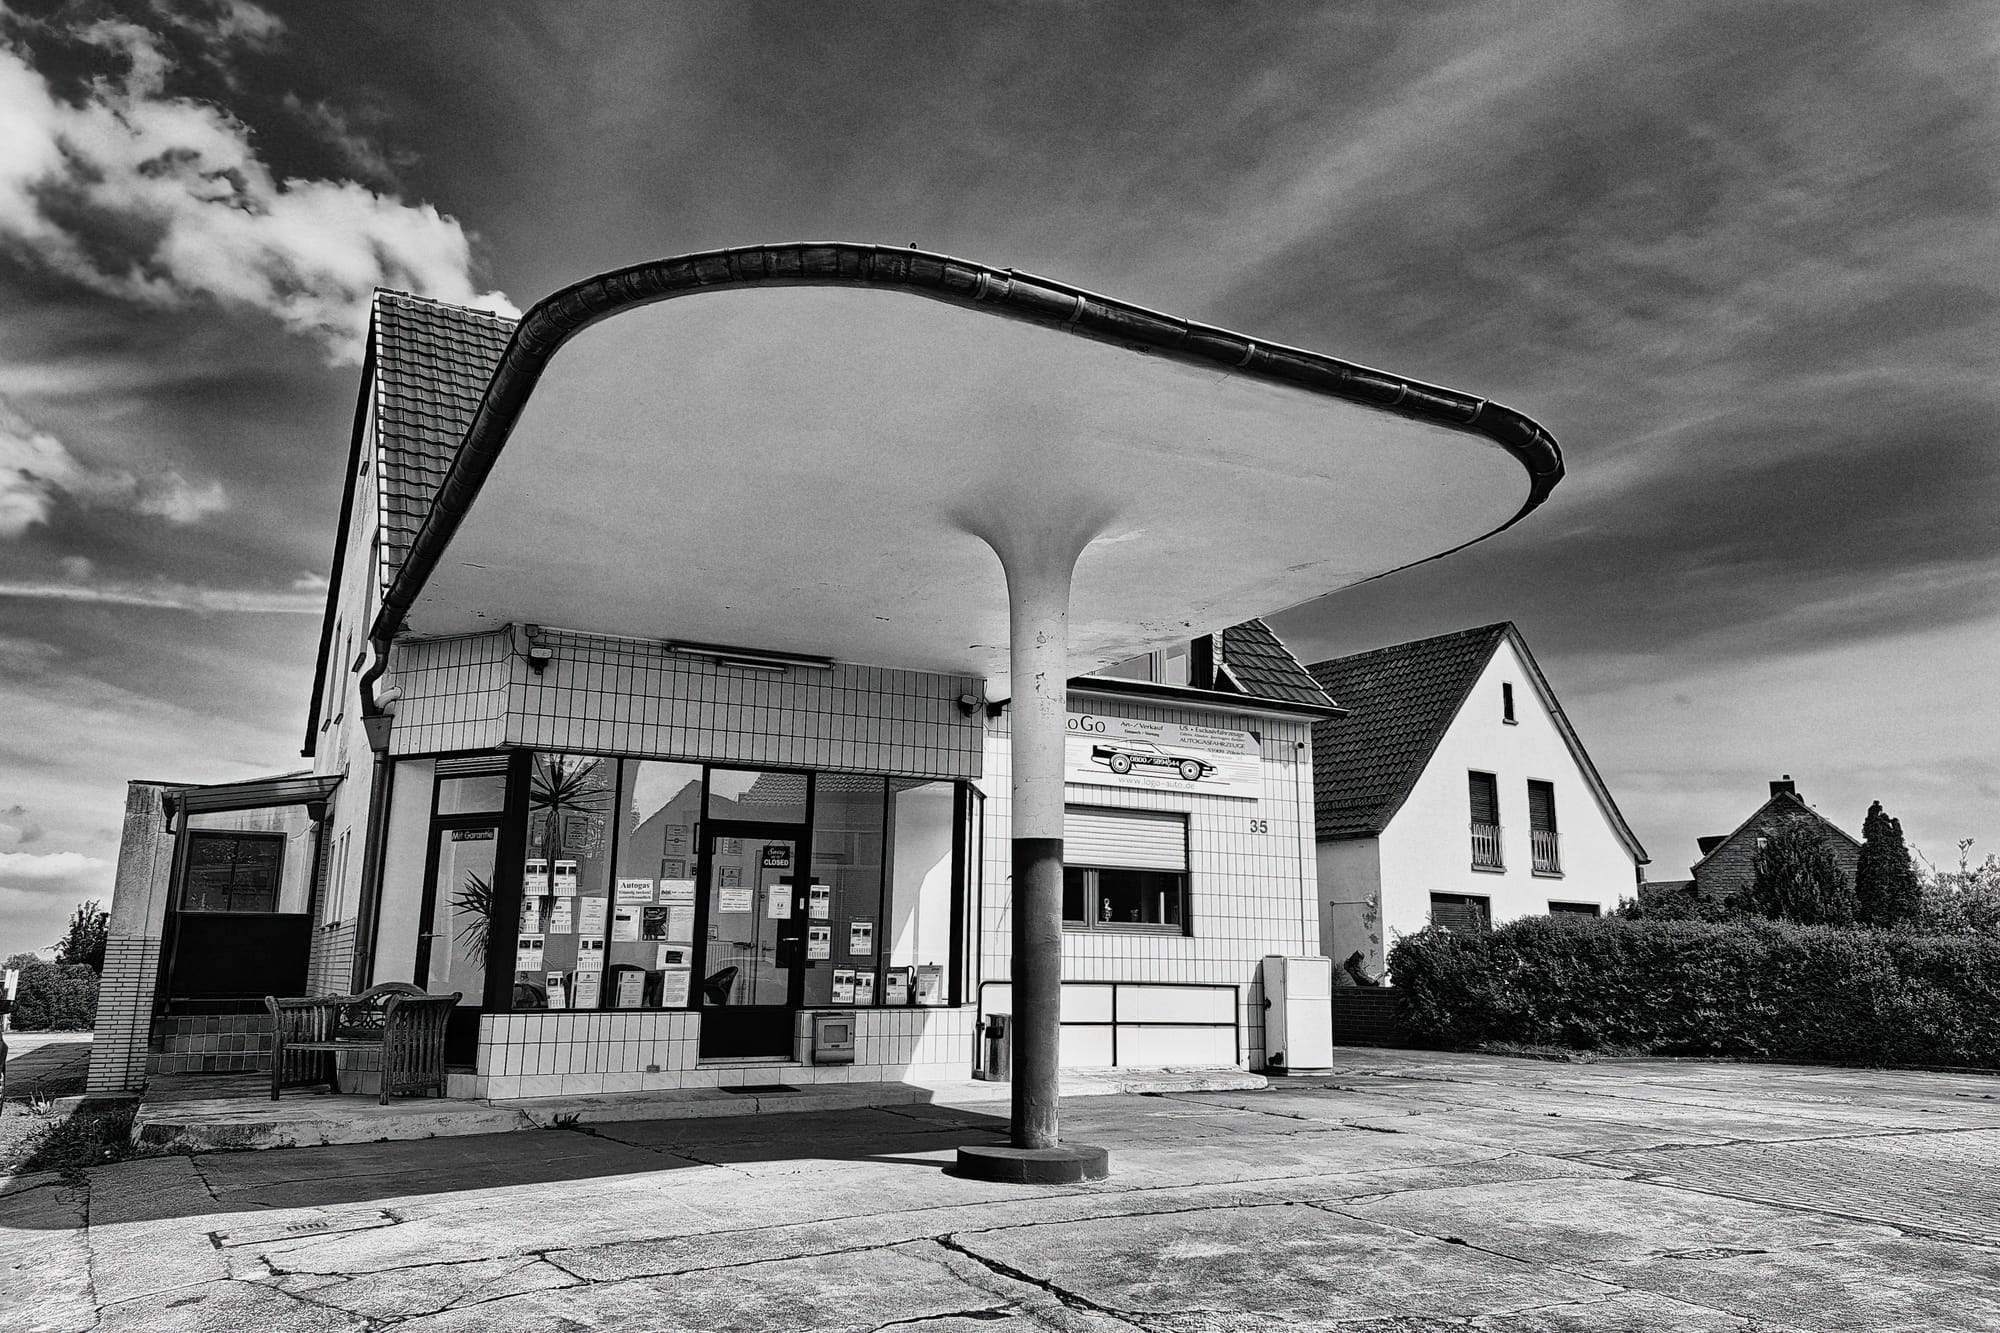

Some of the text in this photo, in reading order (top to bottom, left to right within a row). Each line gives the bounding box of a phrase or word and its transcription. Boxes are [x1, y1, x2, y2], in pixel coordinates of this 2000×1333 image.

[1066, 715, 1106, 733] oGo
[1139, 722, 1164, 731] Verkauf
[1119, 777, 1196, 790] www.logo-auto.de
[1250, 819, 1268, 834] 35
[452, 829, 494, 840] Mit Garantie
[763, 858, 789, 866] CLOSED
[620, 881, 650, 890] Autogas
